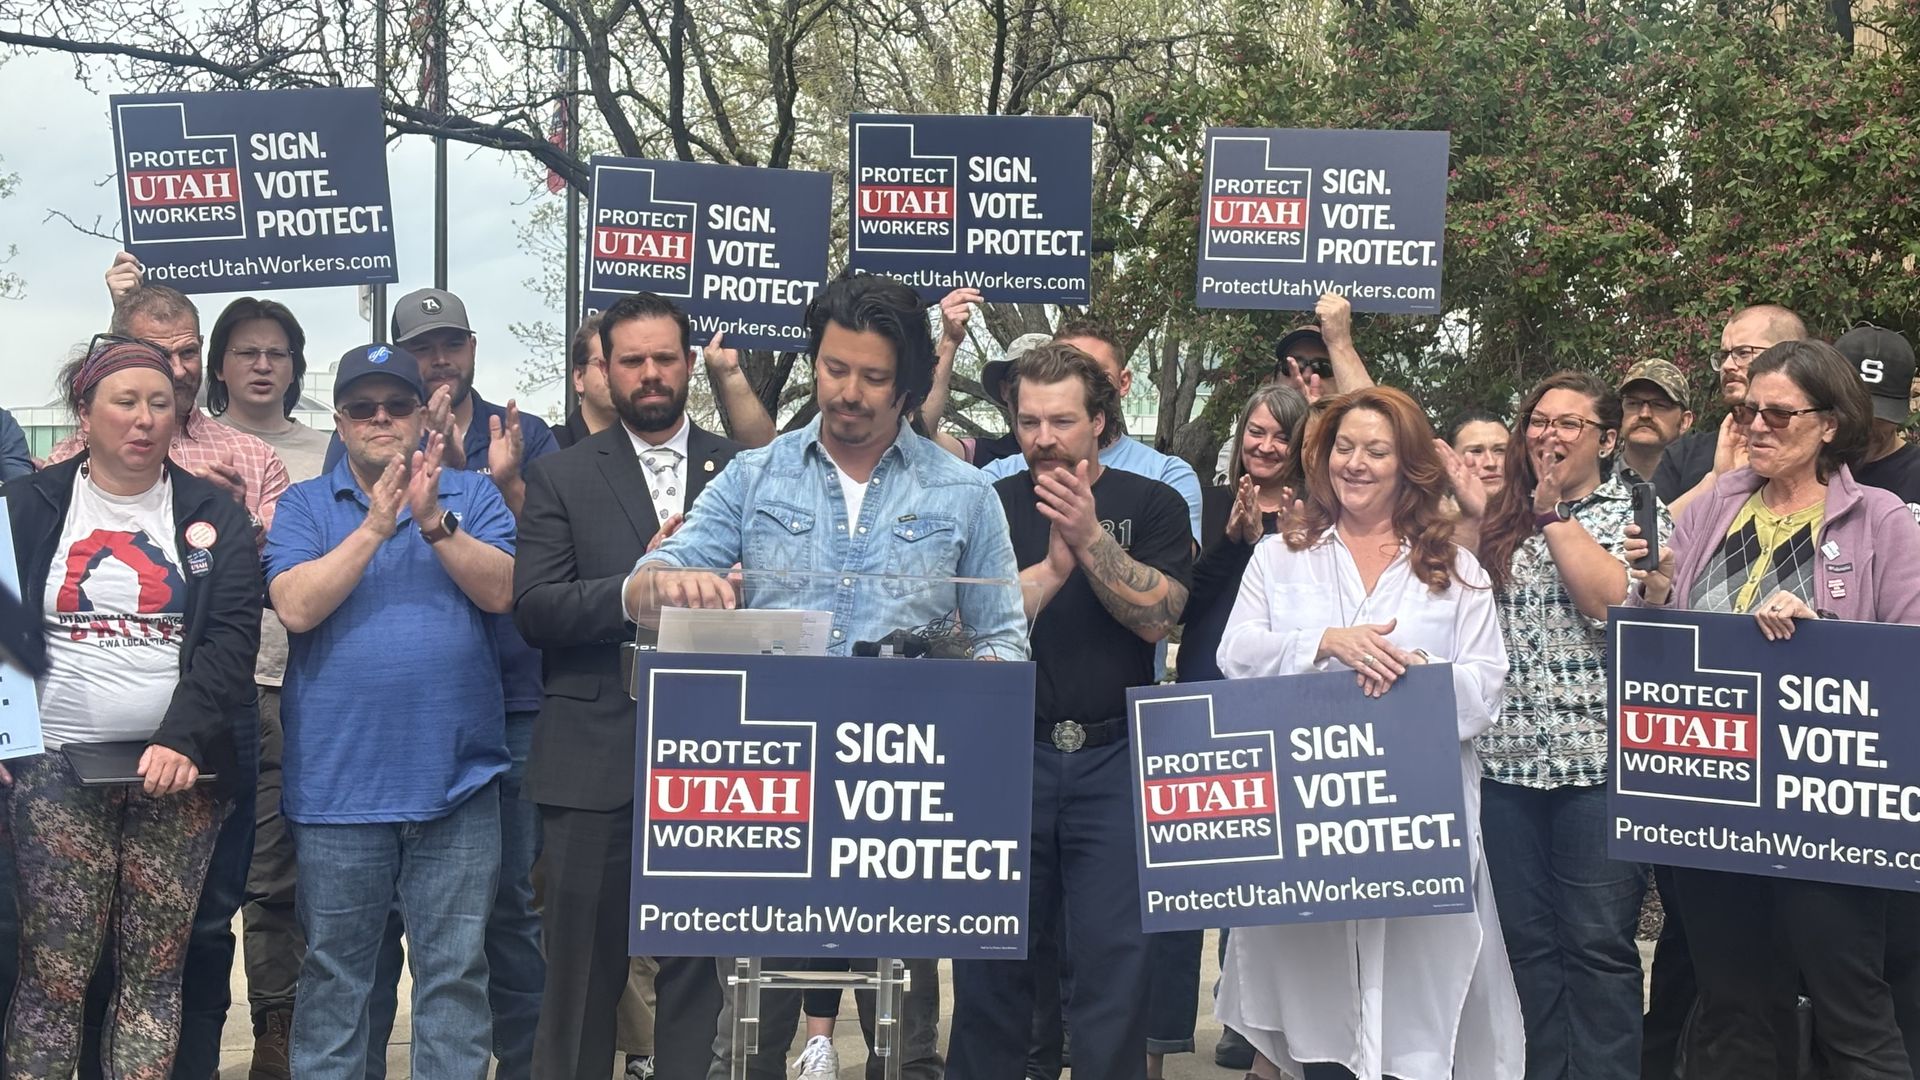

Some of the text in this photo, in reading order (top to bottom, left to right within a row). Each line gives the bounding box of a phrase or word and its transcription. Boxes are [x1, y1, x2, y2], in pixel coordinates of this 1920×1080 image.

[130, 149, 227, 167] PROTECT
[251, 132, 326, 160] SIGN.
[862, 167, 948, 183] PROTECT
[969, 156, 1036, 182] SIGN.
[1323, 169, 1390, 194] SIGN.
[131, 173, 232, 201] UTAH
[254, 170, 337, 198] VOTE.
[1215, 179, 1302, 194] PROTECT
[134, 206, 236, 224] WORKERS
[861, 190, 947, 214] UTAH
[969, 193, 1042, 219] VOTE.
[1214, 201, 1300, 224] UTAH
[257, 206, 387, 237] PROTECT.
[599, 209, 687, 228] PROTECT
[708, 204, 775, 233] SIGN.
[861, 220, 949, 235] WORKERS
[1322, 204, 1395, 229] VOTE.
[598, 231, 685, 258] UTAH
[968, 229, 1085, 256] PROTECT.
[1212, 230, 1300, 245] WORKERS
[708, 239, 779, 268] VOTE.
[1318, 239, 1437, 266] PROTECT.
[596, 261, 685, 279] WORKERS
[856, 269, 1084, 290] ectUtahWorkers.com
[704, 274, 819, 305] PROTECT
[1203, 277, 1435, 300] ProtectUtahWorkers.com
[1860, 359, 1884, 383] S
[59, 614, 91, 624] UTAH
[99, 640, 120, 648] CWA
[123, 638, 150, 647] LOCAL
[1625, 681, 1748, 708] PROTECT
[1779, 675, 1878, 716] SIGN.
[836, 722, 944, 764] SIGN.
[1291, 723, 1384, 761] SIGN.
[1624, 712, 1748, 754] UTAH
[1779, 725, 1887, 768] VOTE.
[658, 740, 801, 764] PROTECT
[1147, 748, 1262, 775] PROTECT
[1624, 752, 1750, 781] WORKERS
[656, 776, 800, 813] UTAH
[835, 780, 953, 821] VOTE.
[1148, 778, 1267, 814] UTAH
[1294, 770, 1396, 808] VOTE.
[653, 825, 800, 848] WORKERS
[1151, 818, 1271, 843] WORKERS
[1296, 813, 1460, 857] PROTECT.
[831, 838, 1020, 880] PROTECT.
[1148, 877, 1464, 914] ProtectUtahWorkers.com
[641, 905, 1018, 934] ProtectUtahWorkers.com
